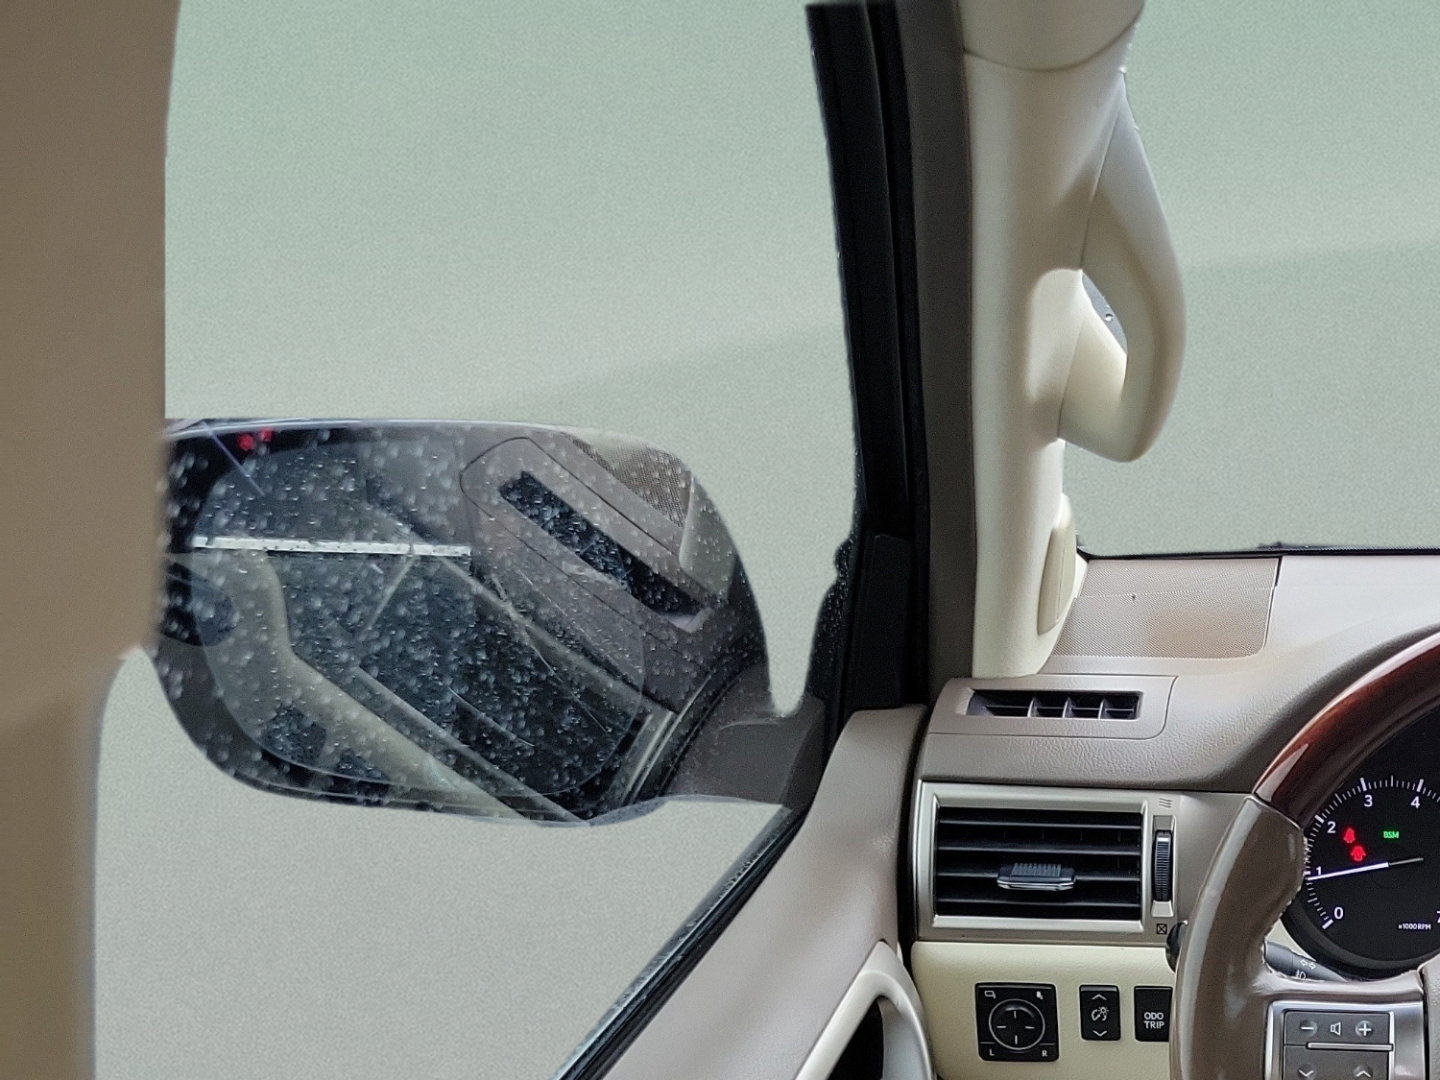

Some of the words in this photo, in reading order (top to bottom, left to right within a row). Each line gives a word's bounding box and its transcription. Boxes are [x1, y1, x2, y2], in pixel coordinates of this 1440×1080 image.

[1363, 794, 1373, 808] 3
[1410, 796, 1421, 809] 4
[1327, 820, 1337, 834] 2
[1334, 906, 1344, 920] 0
[1143, 1012, 1165, 1021] ODO
[1143, 1020, 1165, 1030] TRIP
[988, 1049, 995, 1057] L
[1041, 1050, 1048, 1058] R
